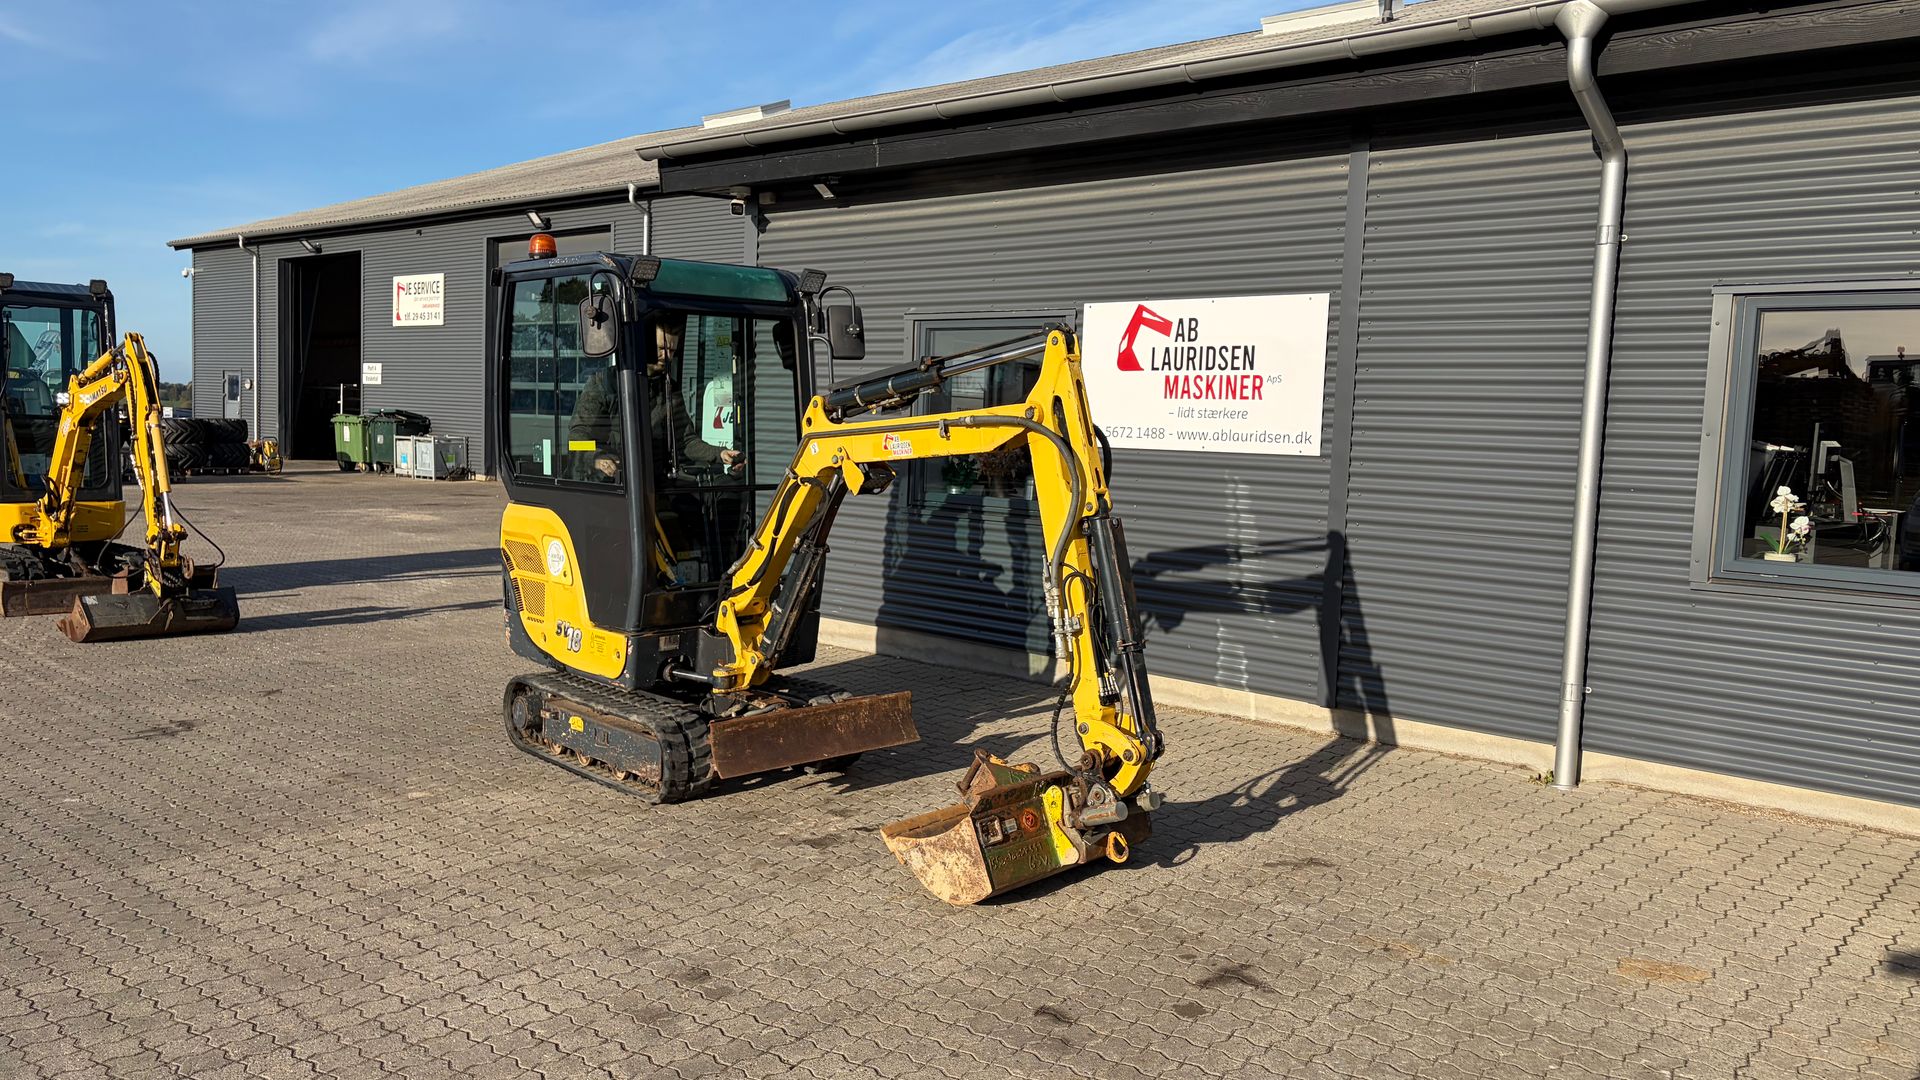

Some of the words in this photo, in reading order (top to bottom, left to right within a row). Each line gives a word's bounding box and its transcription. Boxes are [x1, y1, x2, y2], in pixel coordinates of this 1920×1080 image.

[405, 282, 412, 295] JE
[413, 280, 440, 295] SERVICE
[412, 312, 419, 321] 29
[419, 312, 426, 320] 45
[426, 311, 433, 320] 31
[434, 311, 441, 320] 41
[1174, 317, 1199, 343] AB
[1150, 345, 1256, 371] LAURIDSEN
[1163, 374, 1264, 401] MASKINER
[1266, 374, 1283, 385] ApS
[1177, 406, 1195, 419] lidt
[1197, 407, 1249, 420] stærkere
[1105, 426, 1133, 439] 5672
[1136, 427, 1166, 440] 1488
[1176, 428, 1313, 445] www.ablauridsen.dk
